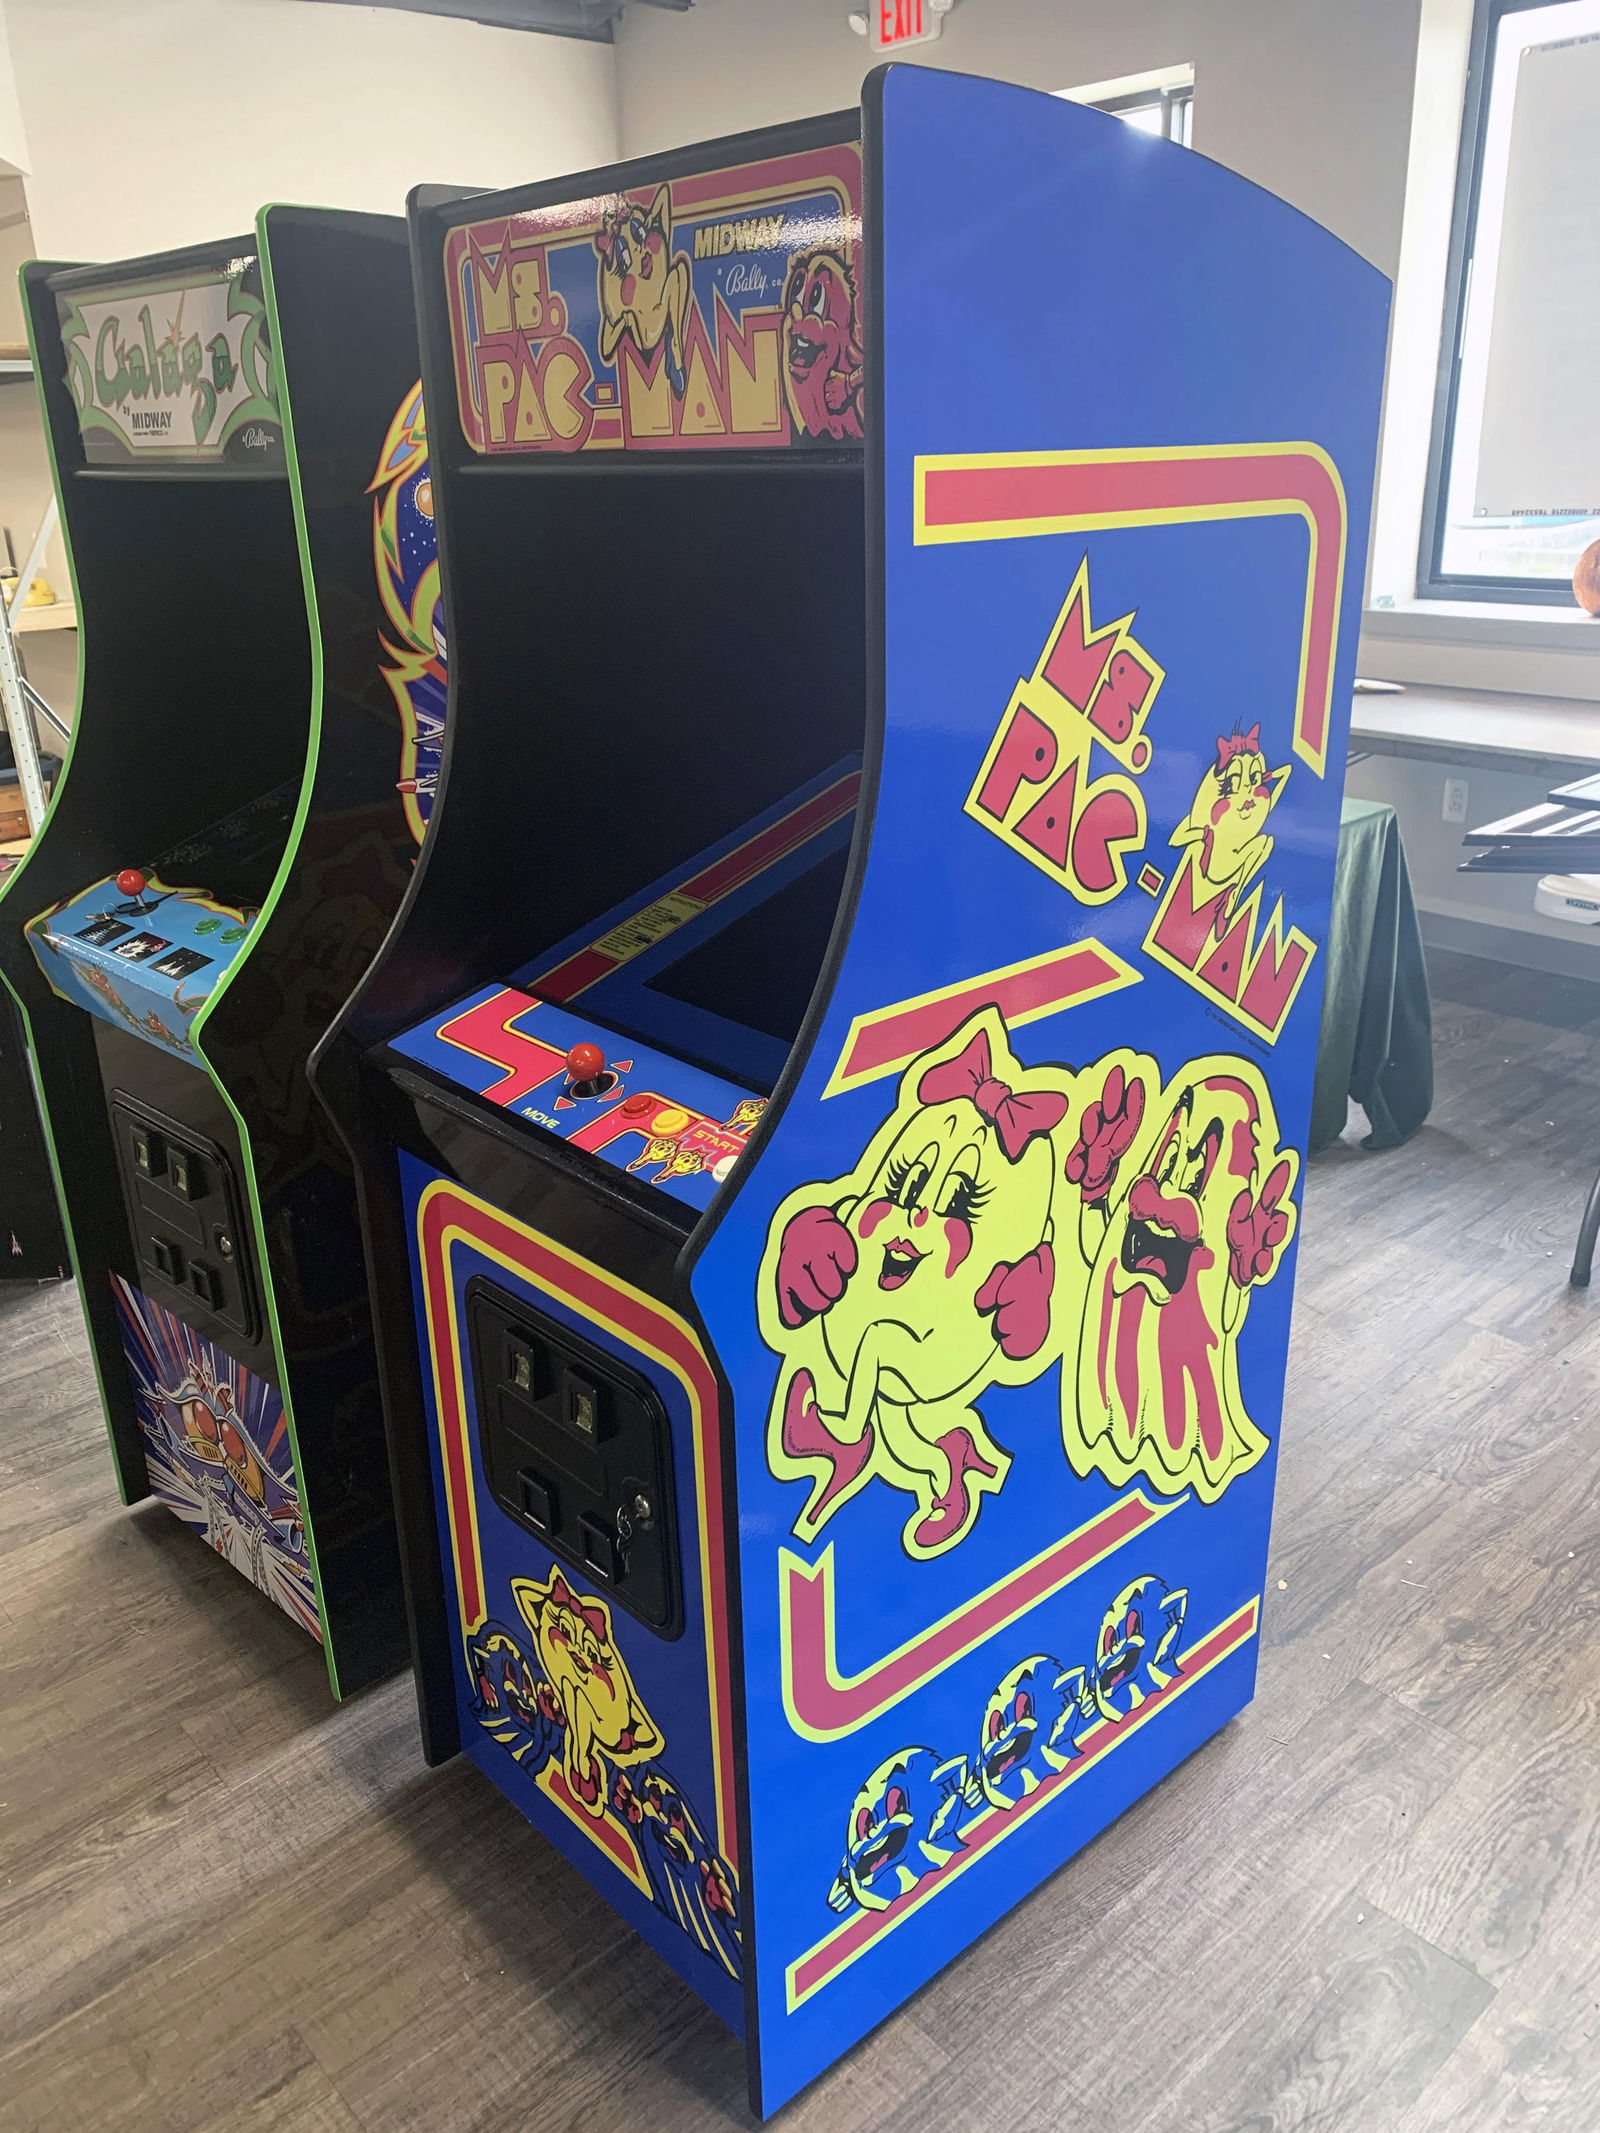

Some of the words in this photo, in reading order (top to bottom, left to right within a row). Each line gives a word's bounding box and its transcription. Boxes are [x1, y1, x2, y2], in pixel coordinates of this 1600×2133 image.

[880, 0, 923, 44] EXIT
[694, 212, 786, 261] MIDWAY
[725, 263, 768, 299] Bally
[132, 411, 172, 430] MIDWAY
[520, 1106, 562, 1130] MOVE
[692, 1129, 741, 1154] START
